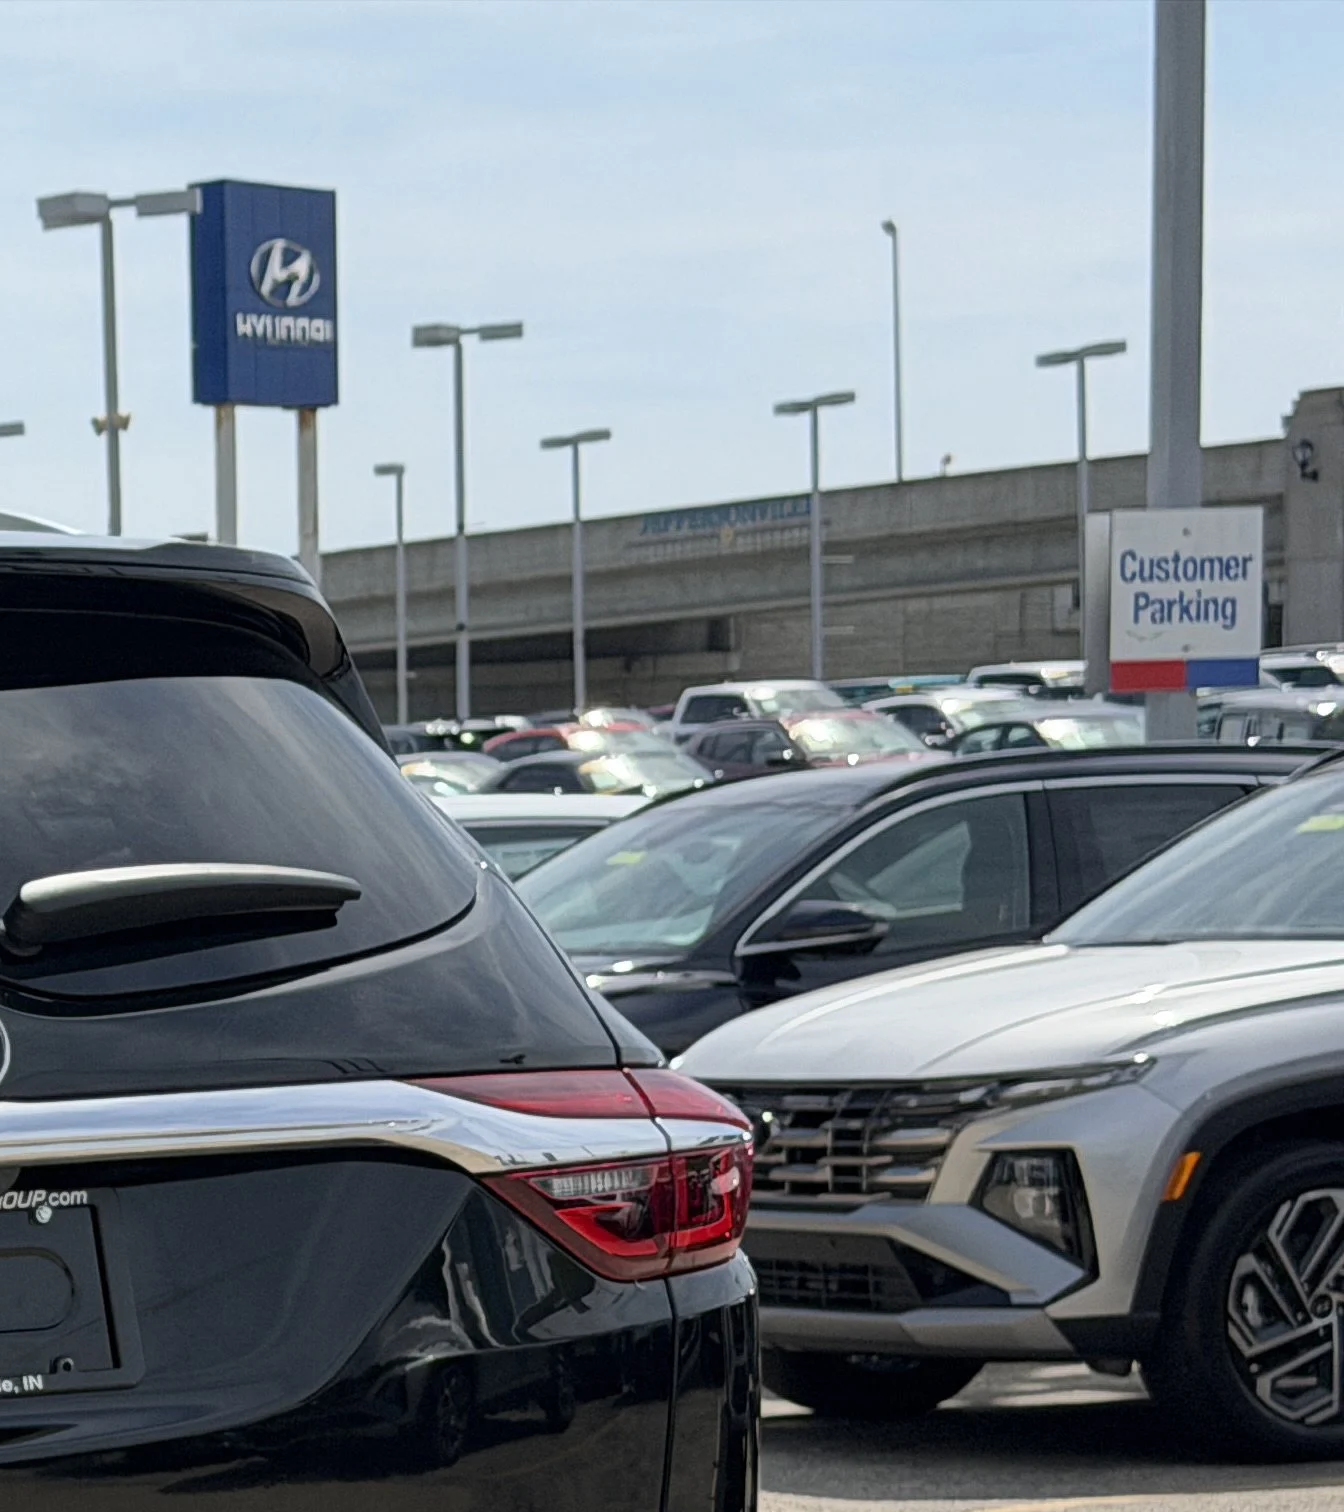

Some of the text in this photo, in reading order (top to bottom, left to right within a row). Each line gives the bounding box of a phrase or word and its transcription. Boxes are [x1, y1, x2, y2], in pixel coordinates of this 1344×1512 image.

[1120, 549, 1253, 583] Customer
[1133, 588, 1238, 630] Parking
[22, 1374, 44, 1391] IN
